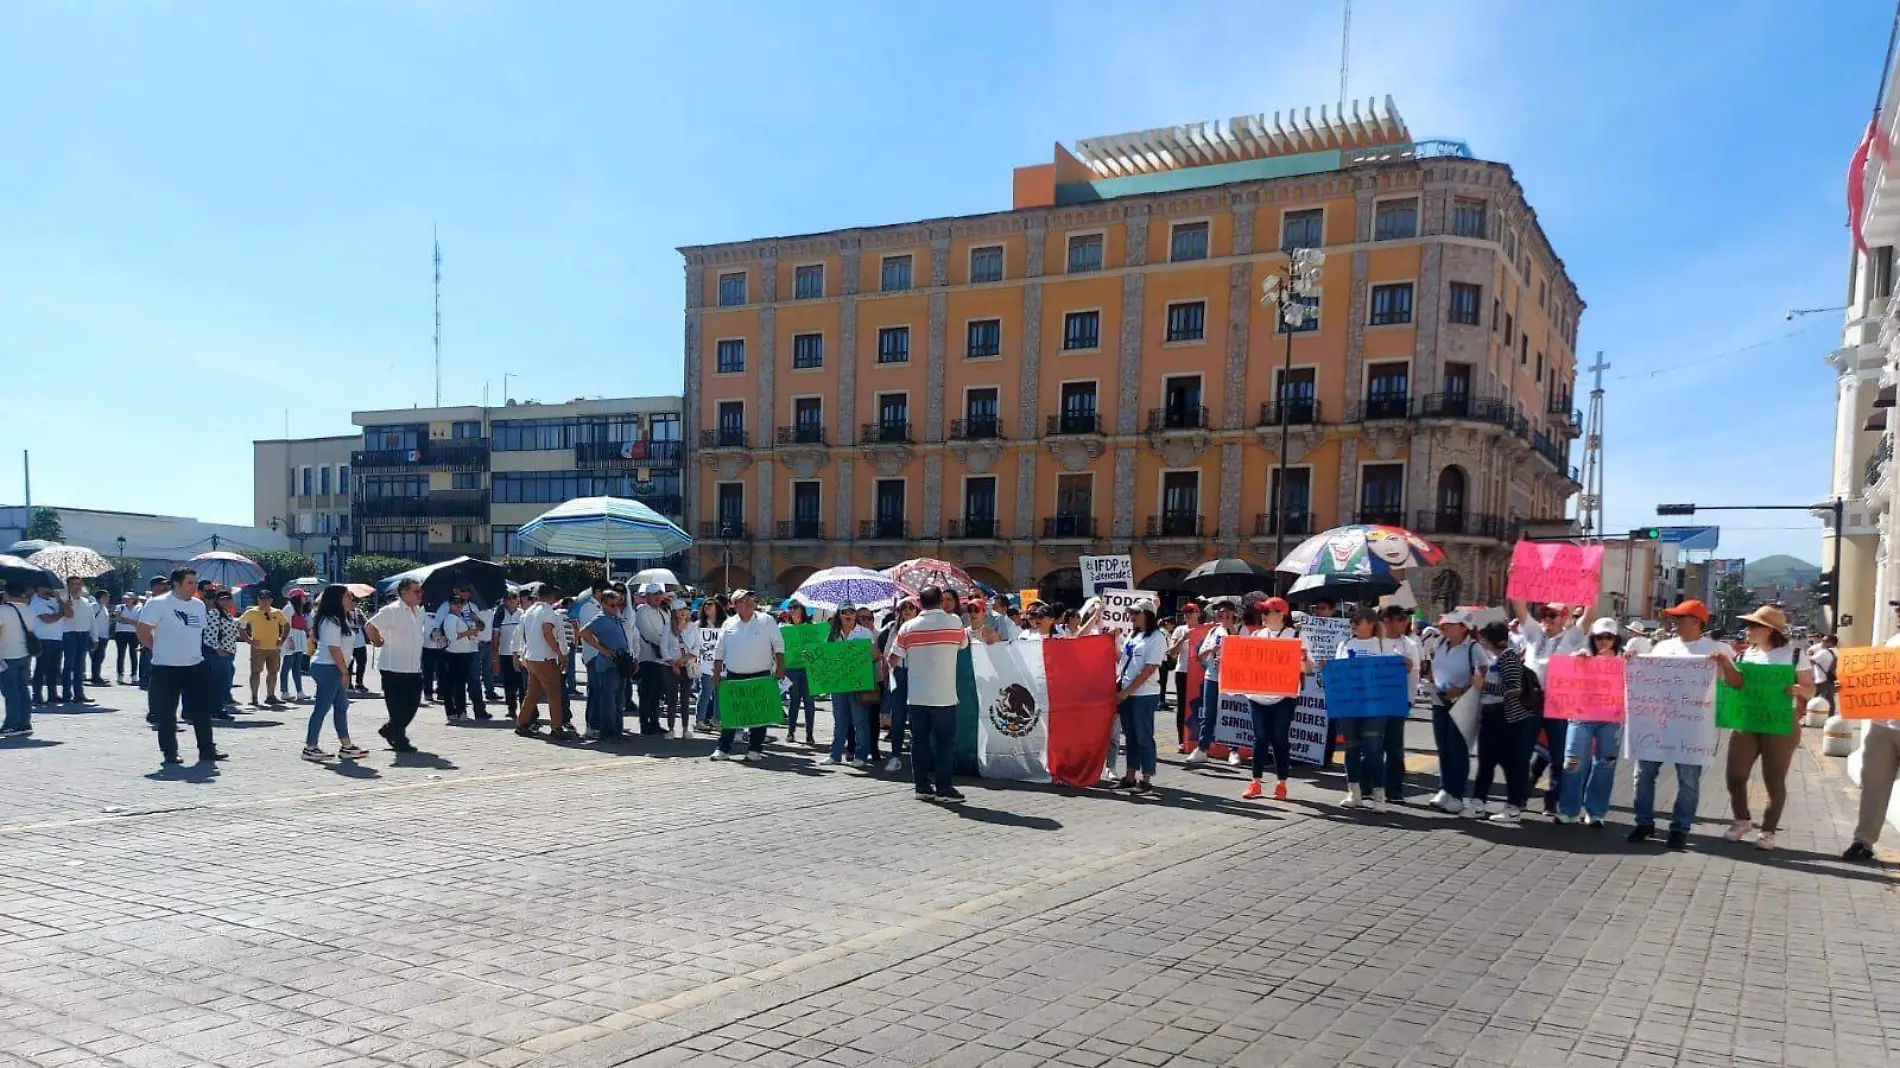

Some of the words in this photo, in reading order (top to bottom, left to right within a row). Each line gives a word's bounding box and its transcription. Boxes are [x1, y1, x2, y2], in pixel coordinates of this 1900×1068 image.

[1095, 559, 1119, 572] IFDP
[1103, 610, 1133, 623] SOM
[1843, 652, 1896, 674] RESPETO
[1299, 696, 1326, 710] DICIA
[1221, 700, 1249, 714] DIVIS
[1296, 712, 1327, 728] DERES
[1221, 715, 1253, 730] SINDI
[1290, 727, 1325, 745] CIONAL
